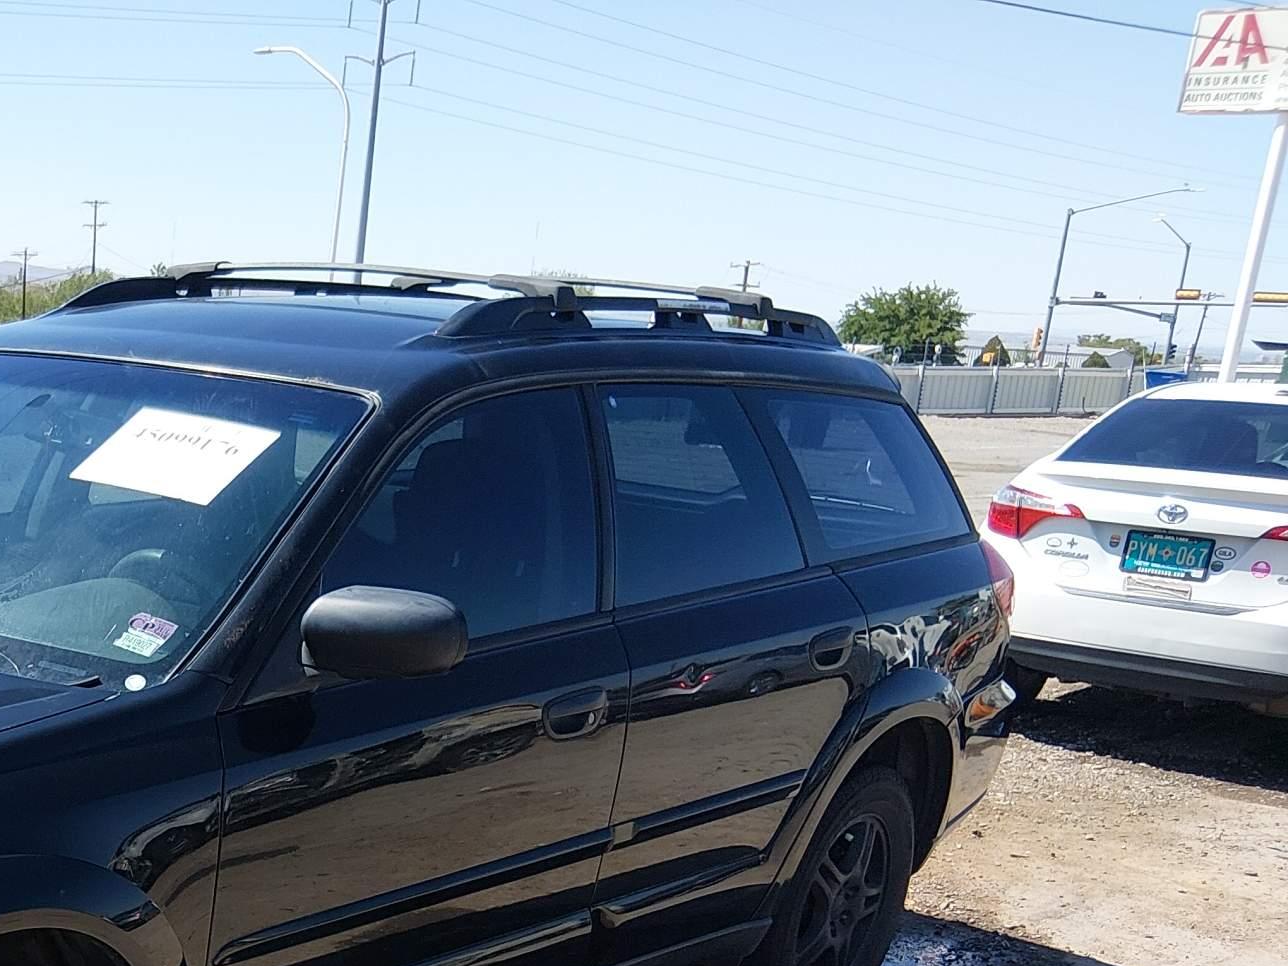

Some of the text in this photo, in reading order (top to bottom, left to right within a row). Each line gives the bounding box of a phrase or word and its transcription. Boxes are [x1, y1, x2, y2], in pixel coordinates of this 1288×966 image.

[1187, 75, 1268, 88] INSURANCE
[1184, 91, 1263, 103] AUTO AUCTIONS
[1127, 540, 1158, 561] PYM
[1175, 546, 1208, 567] 067
